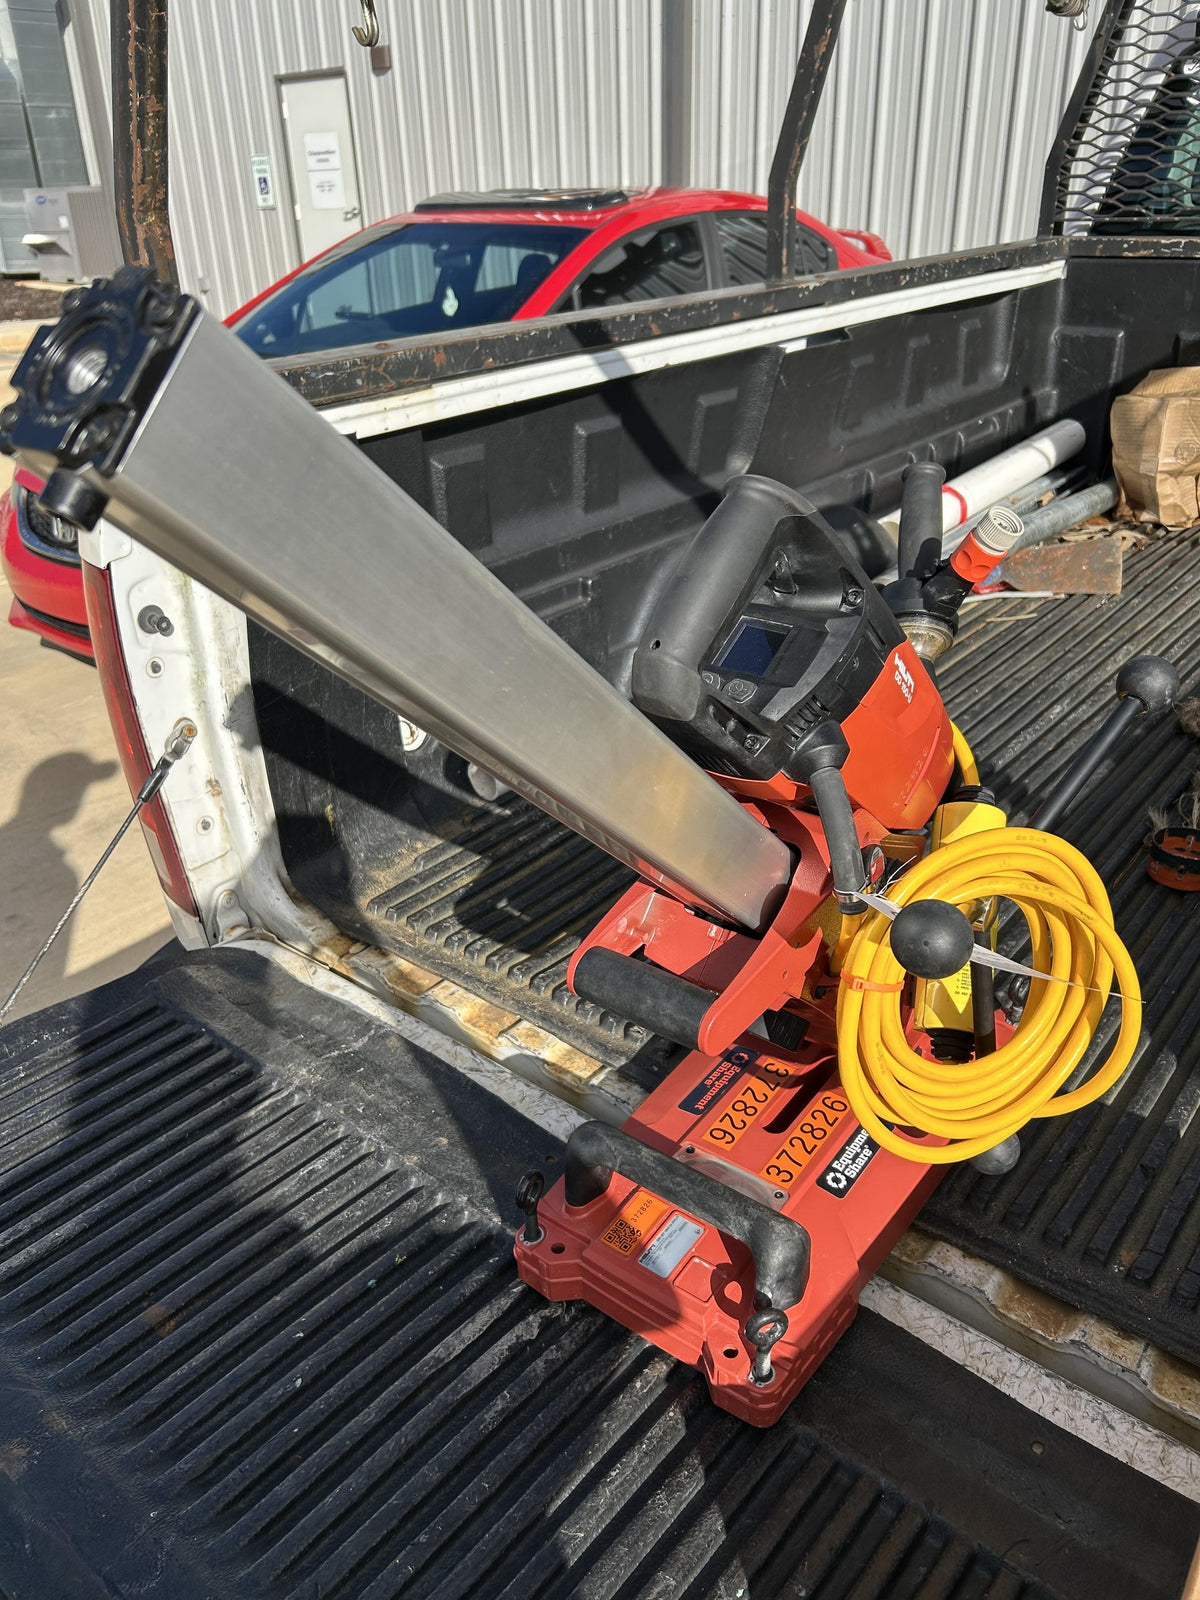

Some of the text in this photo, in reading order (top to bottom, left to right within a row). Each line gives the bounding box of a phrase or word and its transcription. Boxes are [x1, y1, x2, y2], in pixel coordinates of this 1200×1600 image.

[894, 652, 915, 694] HILTI
[894, 670, 903, 686] DD
[694, 1065, 741, 1111] Equipment
[704, 1061, 733, 1086] Share
[709, 1063, 789, 1145] 372826
[765, 1096, 848, 1183] 372826
[831, 1128, 870, 1172] Equipme
[630, 1198, 653, 1223] 372826
